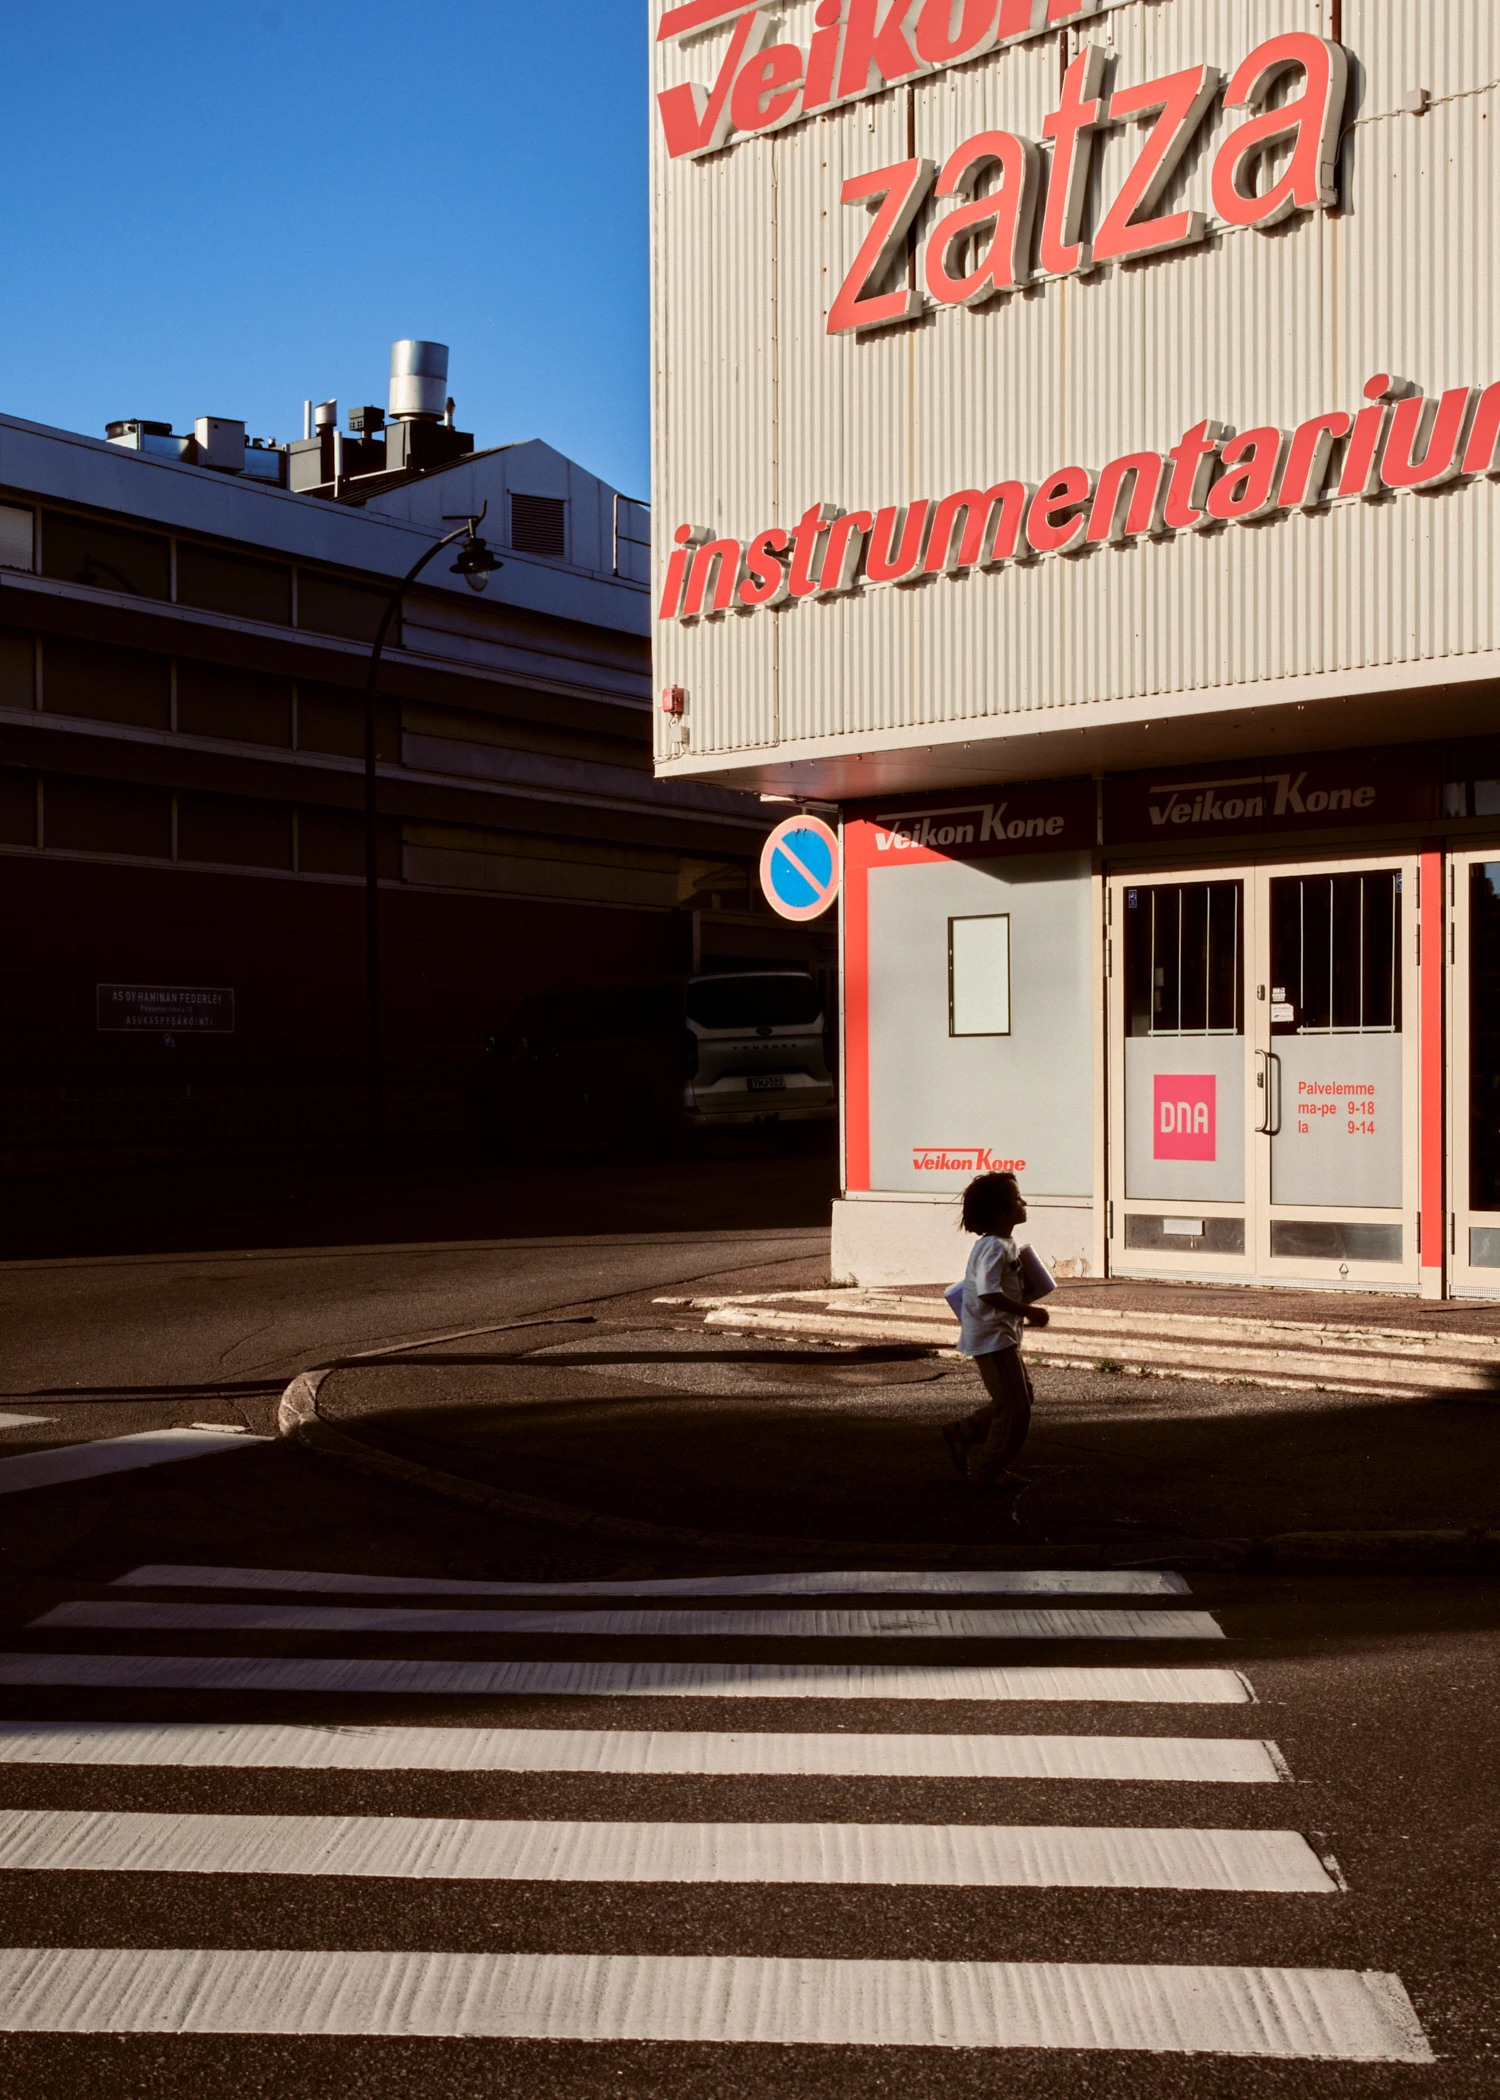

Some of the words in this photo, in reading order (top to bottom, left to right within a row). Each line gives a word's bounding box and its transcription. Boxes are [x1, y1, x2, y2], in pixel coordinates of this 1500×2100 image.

[826, 31, 1340, 335] zatza
[1149, 789, 1266, 825] Veikon
[1273, 772, 1376, 815] Kone
[875, 817, 974, 850] Veikon
[979, 802, 1064, 842] Kone
[112, 991, 123, 1001] AS
[138, 992, 177, 1003] HAMINAN
[180, 993, 223, 1004] FEDERLEY
[125, 1014, 213, 1026] ASUKASPYSÄKÖINTI
[1298, 1081, 1375, 1095] Palvelemme
[1298, 1103, 1337, 1117] ma-pe
[1347, 1101, 1375, 1115] 9-18
[1298, 1120, 1309, 1133] la
[1347, 1120, 1375, 1134] 9-14
[912, 1153, 973, 1170] Veikon
[975, 1148, 1026, 1171] Kone
